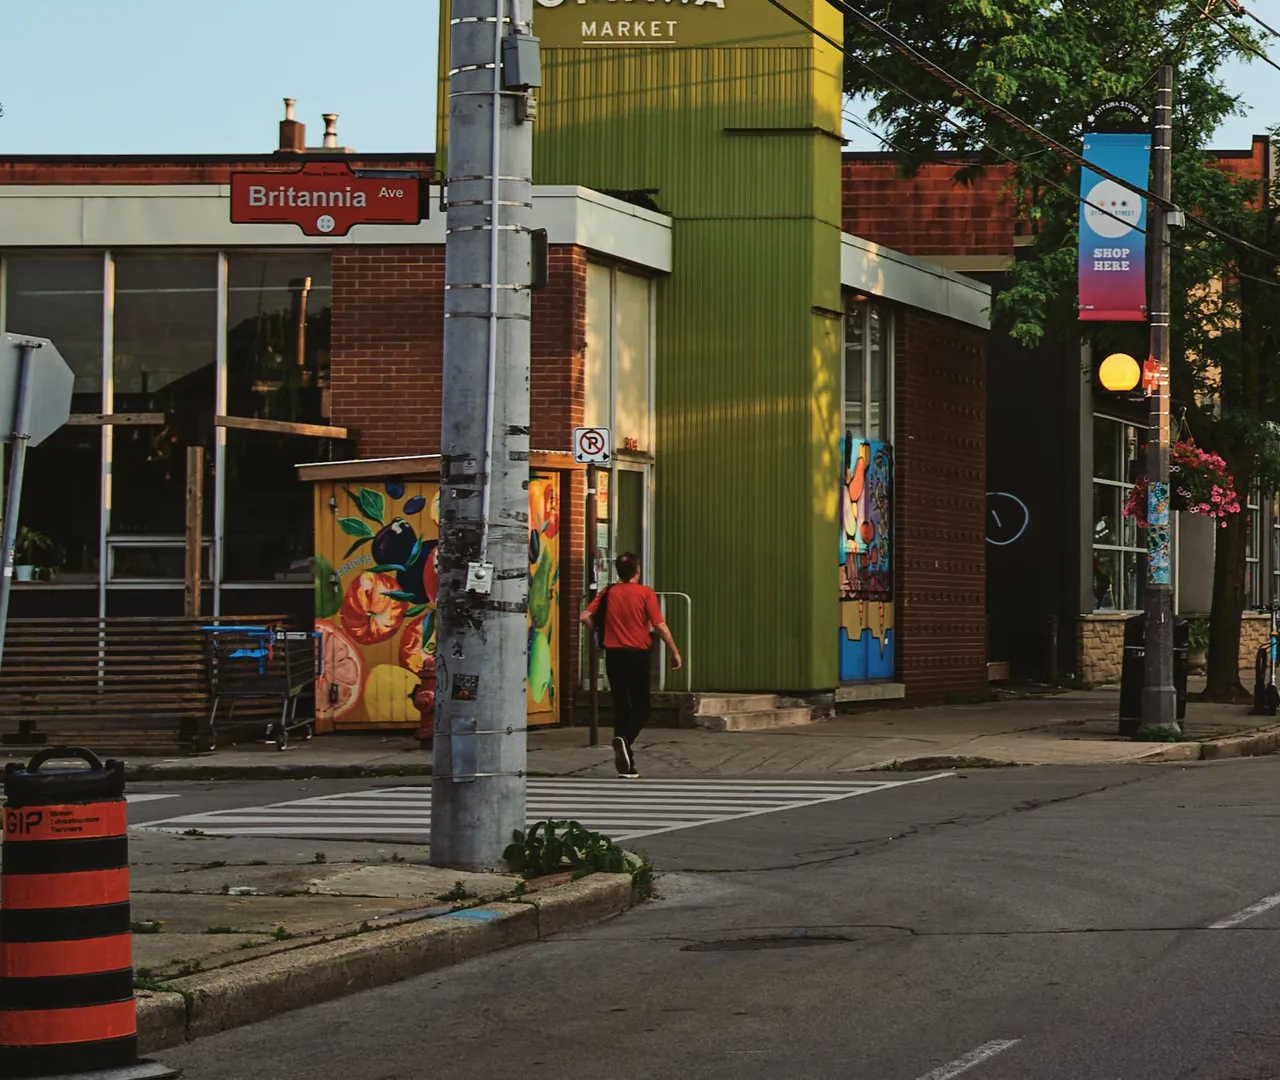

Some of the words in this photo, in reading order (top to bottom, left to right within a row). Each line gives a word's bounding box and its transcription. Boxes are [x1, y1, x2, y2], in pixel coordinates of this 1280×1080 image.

[581, 21, 677, 37] MARKET
[1095, 101, 1119, 116] OTTAWA
[1120, 101, 1142, 116] STREET
[249, 185, 367, 207] Britannia
[378, 187, 404, 198] Ave
[1093, 248, 1130, 259] SHOP
[1093, 261, 1130, 272] HERE
[7, 811, 43, 835] GIP
